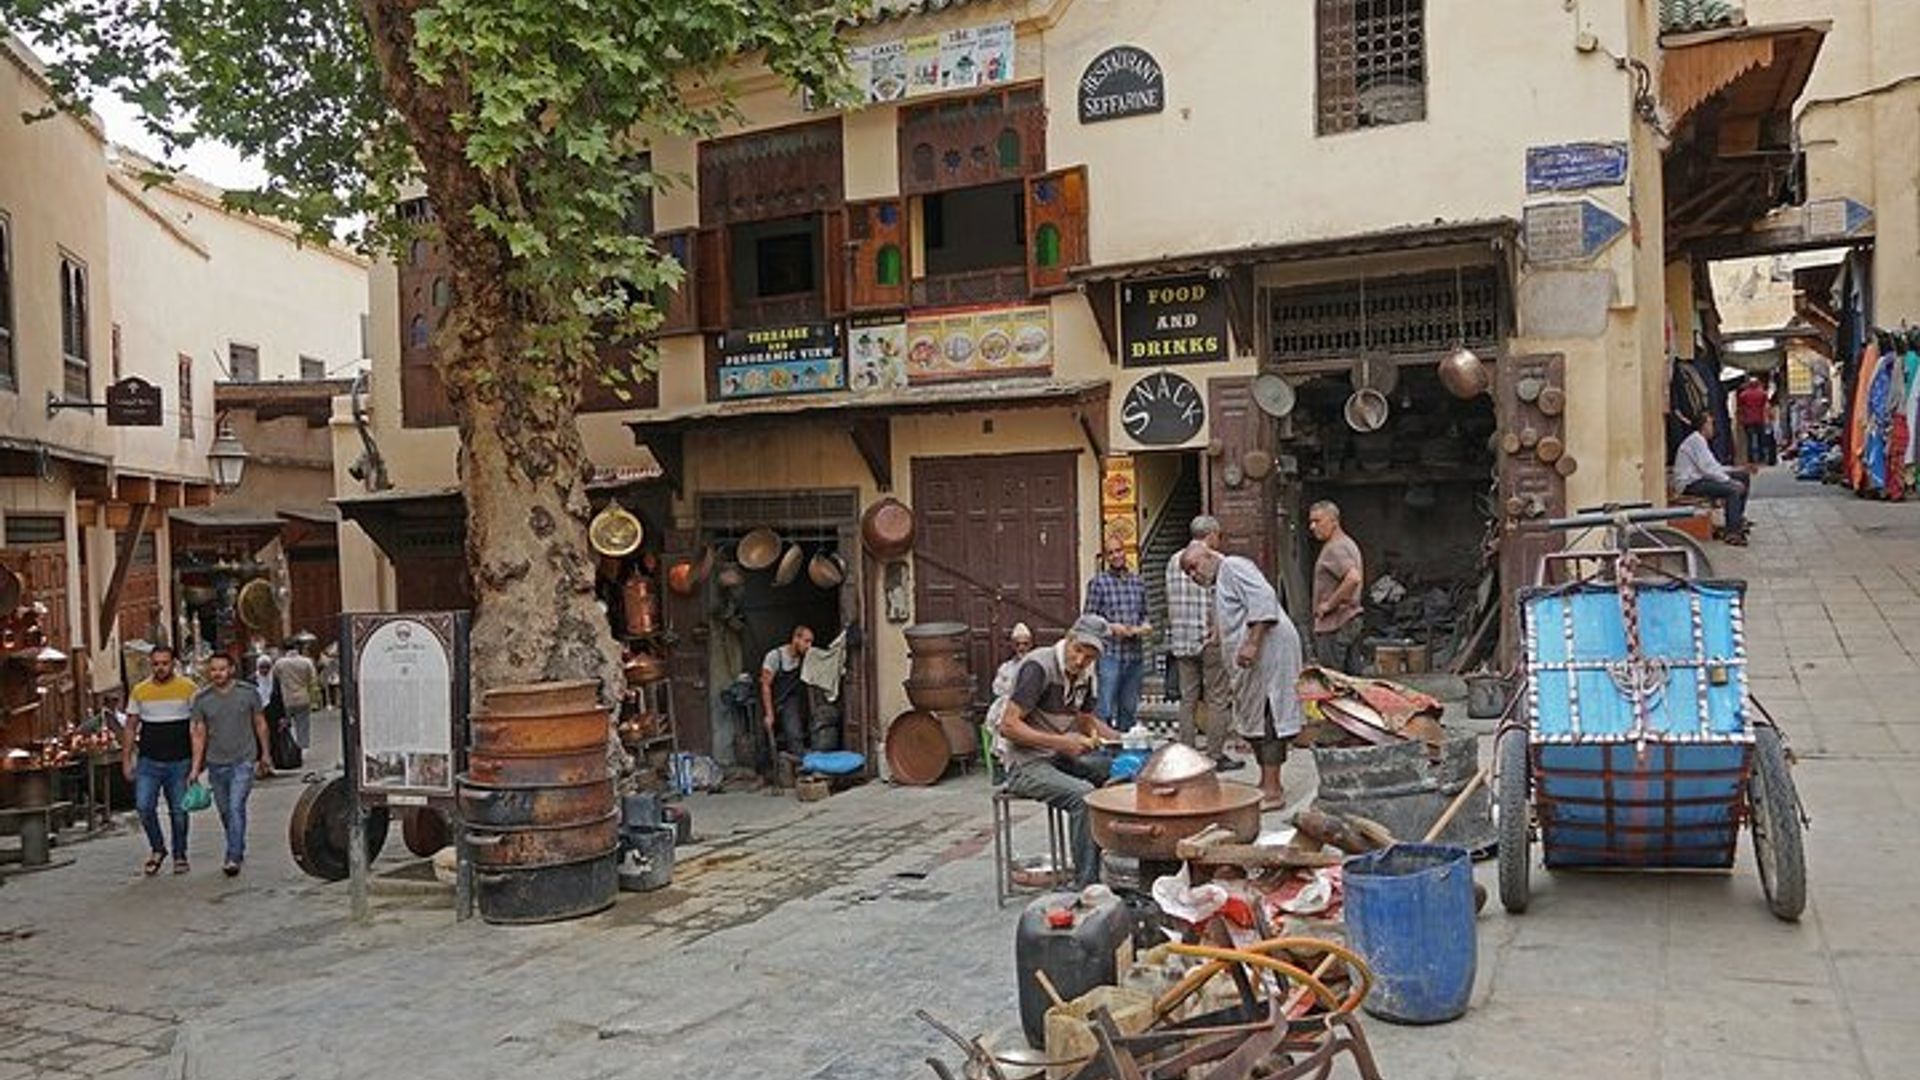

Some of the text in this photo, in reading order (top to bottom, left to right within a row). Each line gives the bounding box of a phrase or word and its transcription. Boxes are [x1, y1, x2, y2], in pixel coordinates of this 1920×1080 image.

[1083, 50, 1159, 95] RESTAURANT
[1085, 89, 1158, 116] SEFFARINE
[1147, 286, 1207, 304] FOOD
[1156, 313, 1198, 329] AND
[800, 348, 833, 360] VIEW
[1131, 337, 1218, 357] DRINKS
[1122, 376, 1202, 435] SNACK
